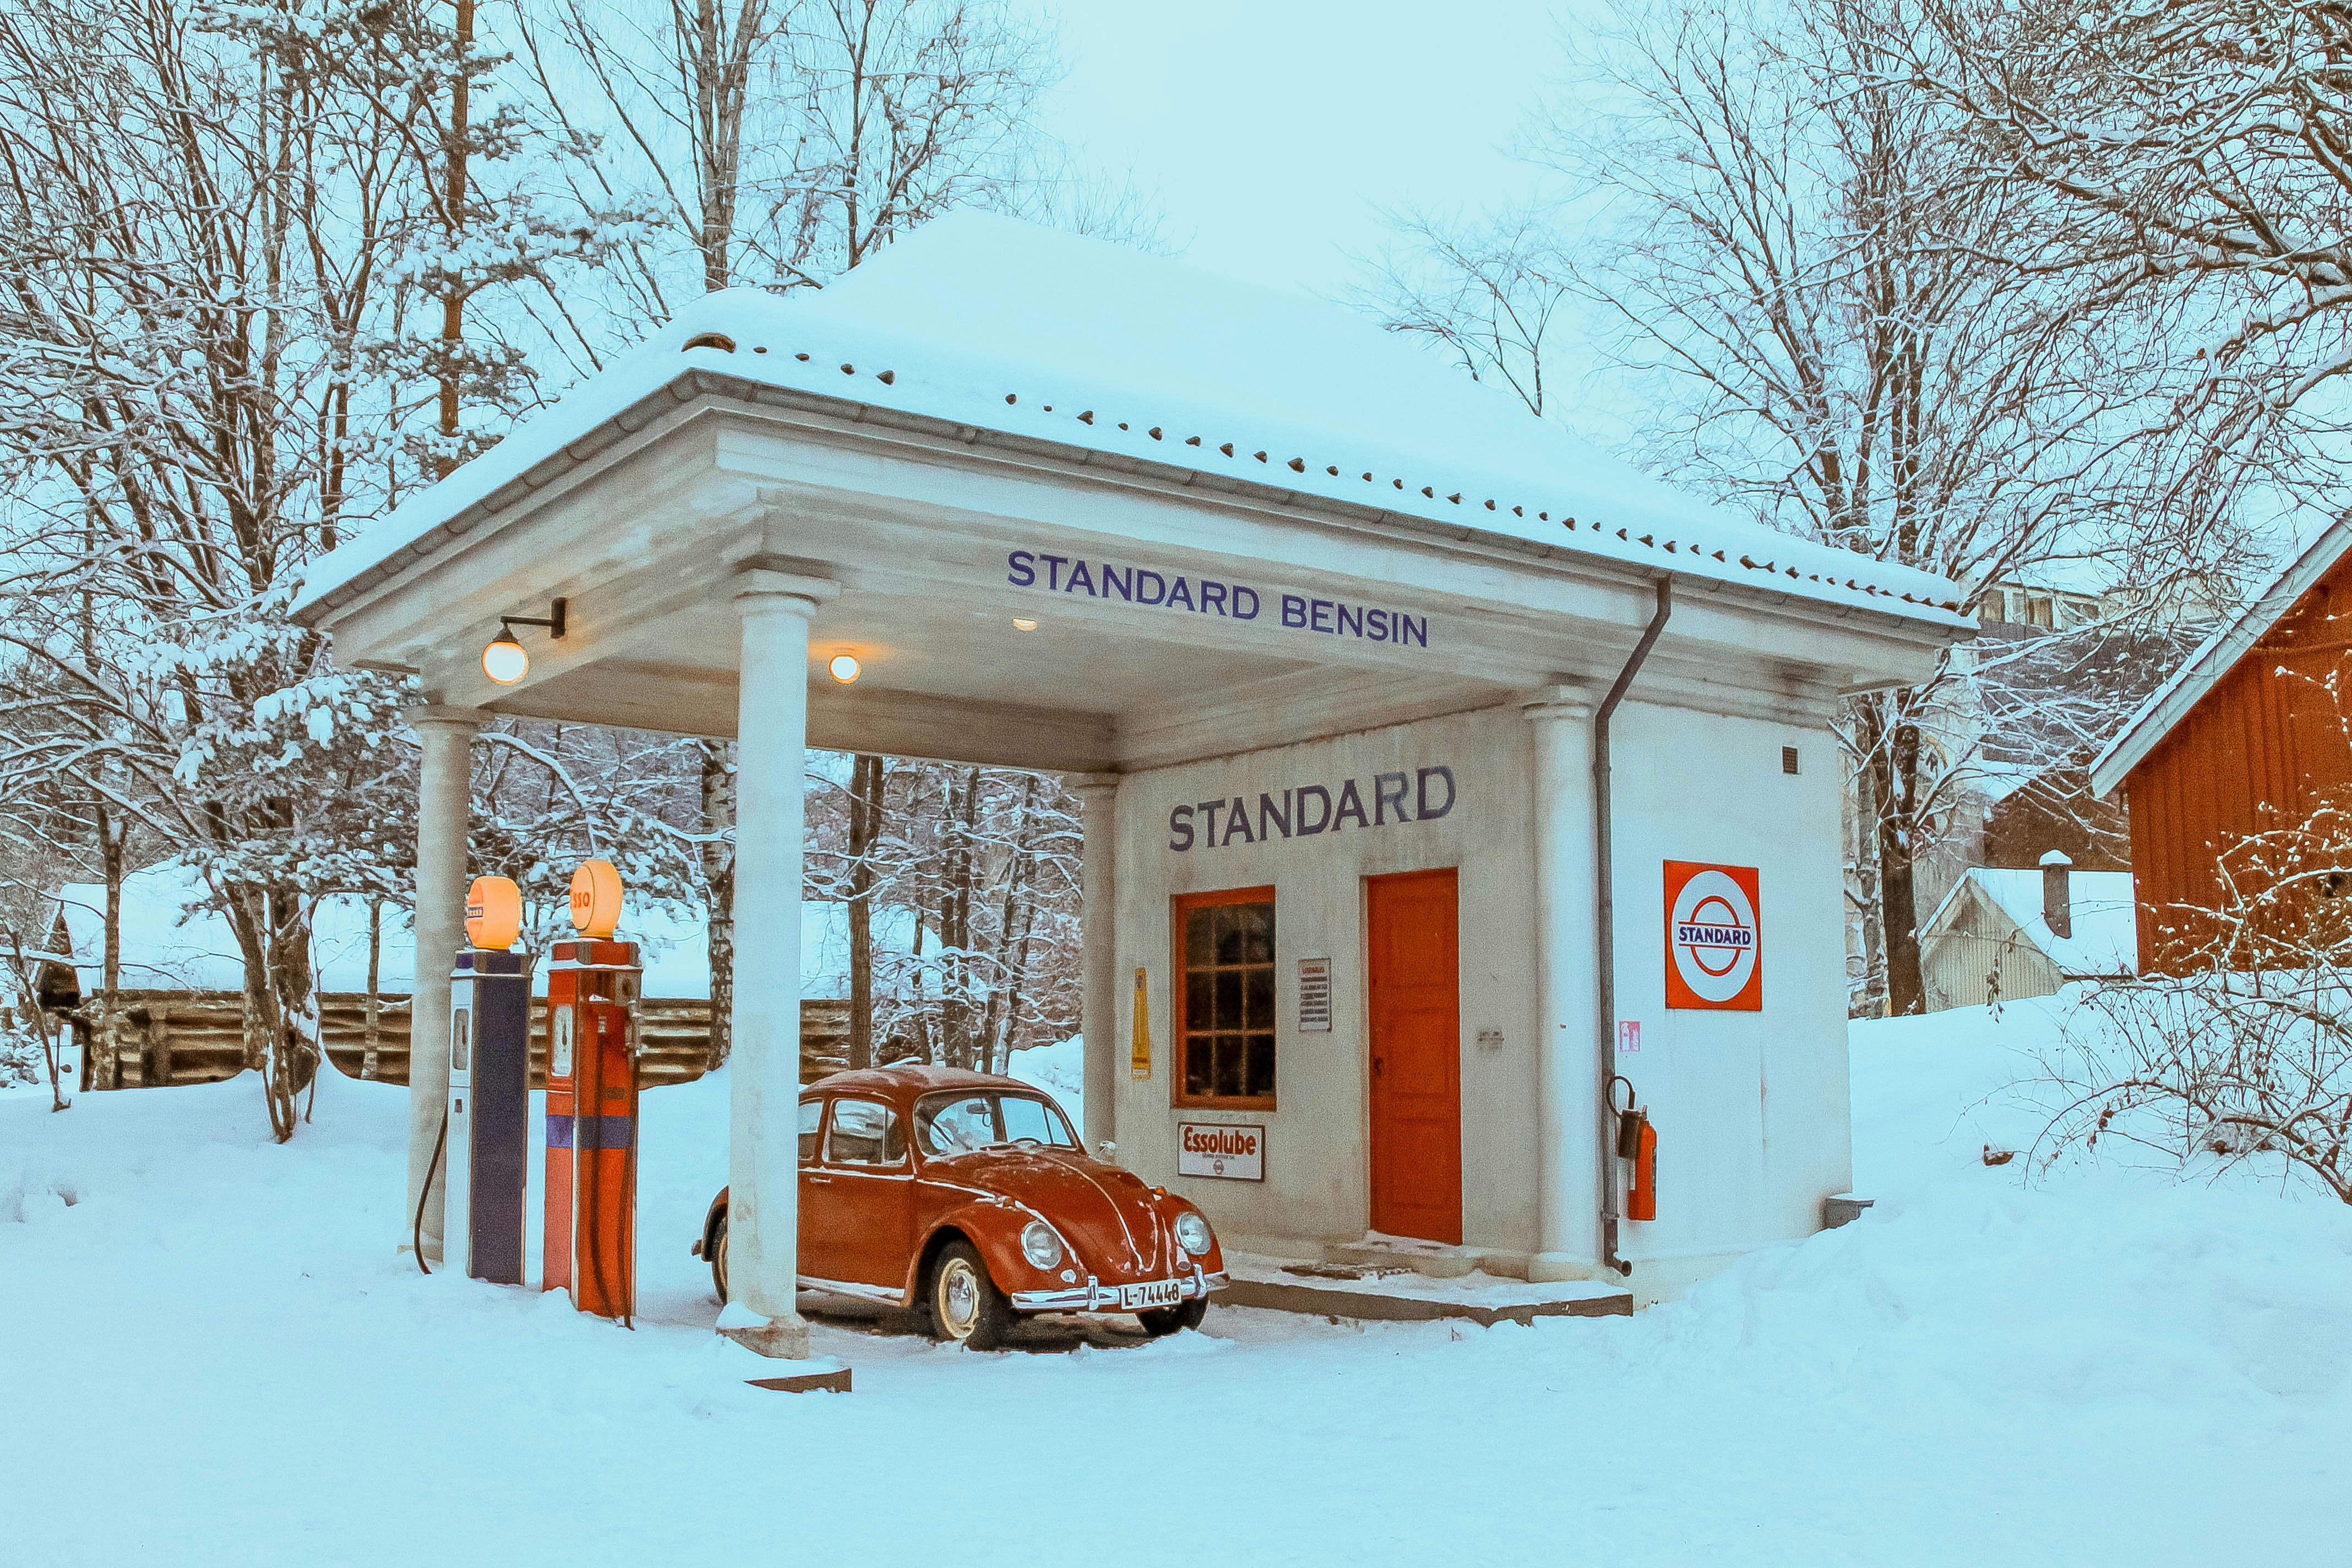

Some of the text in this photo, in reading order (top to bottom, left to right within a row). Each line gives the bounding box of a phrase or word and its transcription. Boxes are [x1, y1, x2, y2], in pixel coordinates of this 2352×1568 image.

[1008, 550, 1427, 647] STANDARD BENSIN
[1169, 765, 1456, 852] STANDARD
[1679, 926, 1751, 945] STANDARD
[1184, 1126, 1256, 1155] Essolube
[1124, 1283, 1179, 1305] L-74448
